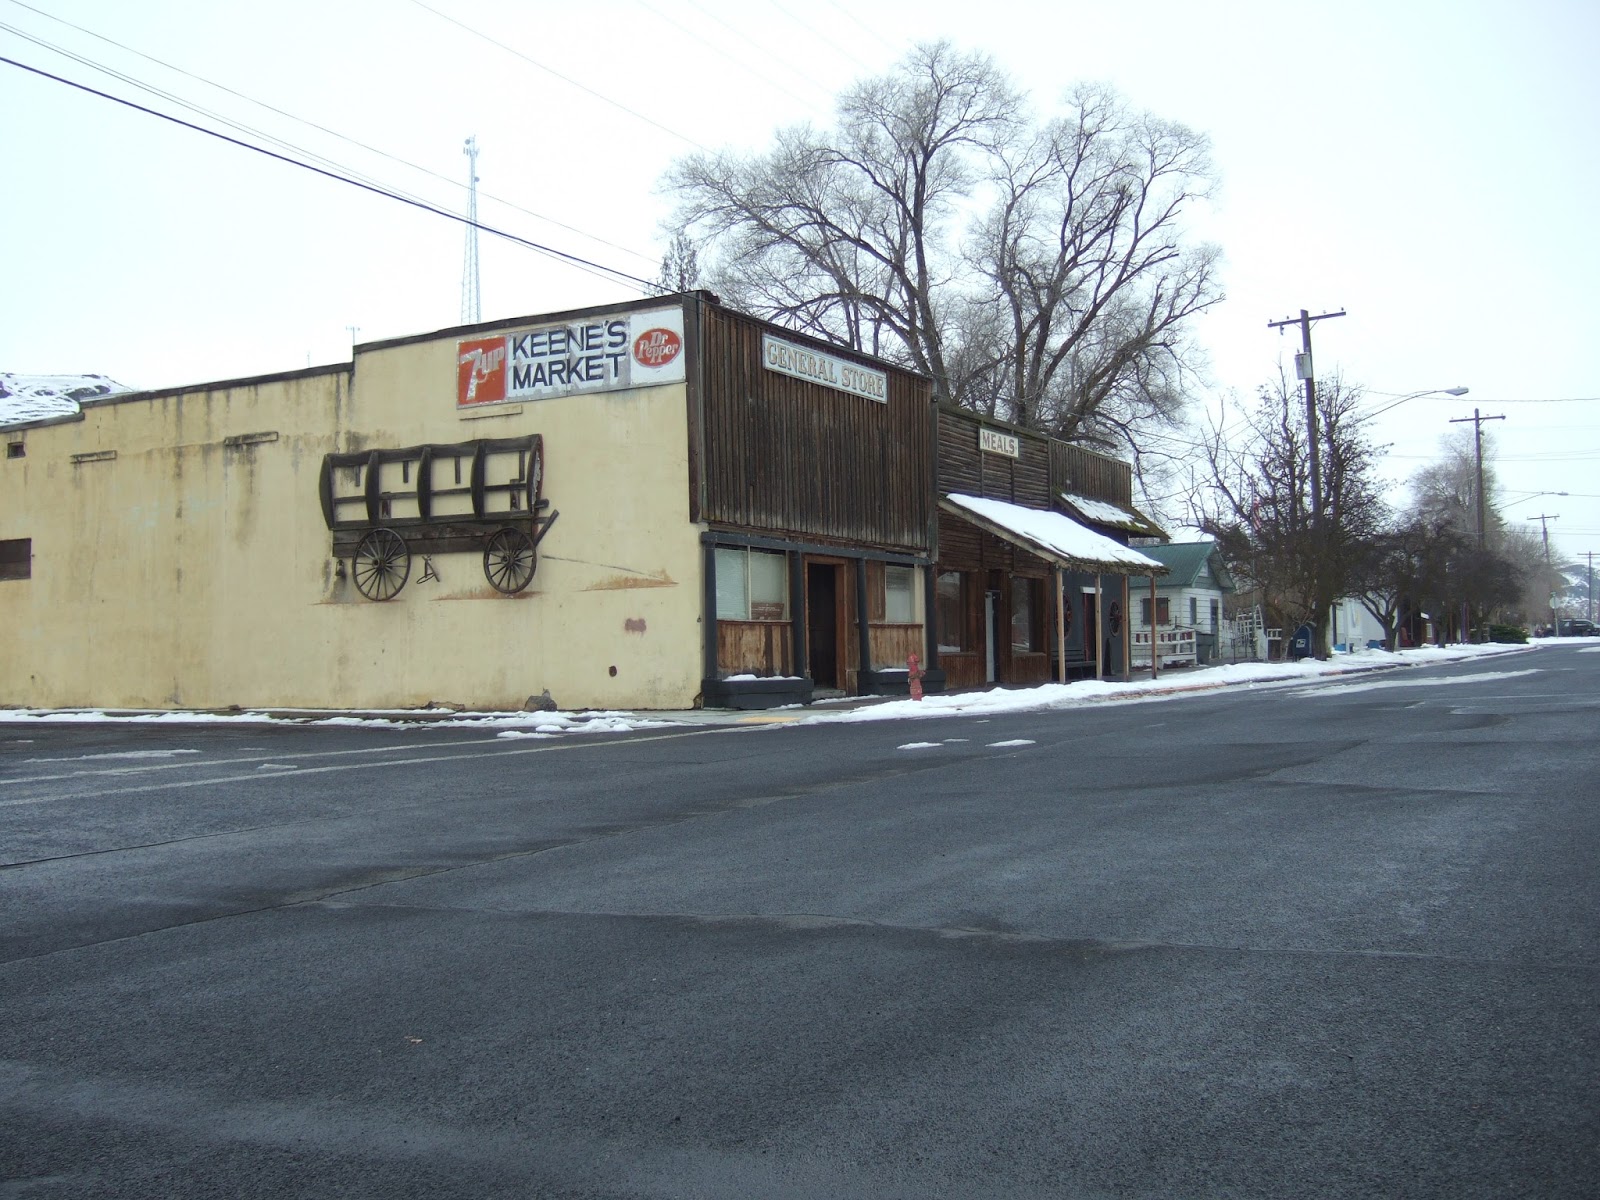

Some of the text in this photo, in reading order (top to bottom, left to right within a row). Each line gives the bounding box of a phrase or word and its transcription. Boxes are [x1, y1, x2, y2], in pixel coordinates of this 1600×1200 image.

[512, 320, 627, 360] KEENE'S
[638, 340, 679, 363] Pepper
[650, 331, 668, 347] Dr
[512, 352, 627, 390] MARKET
[766, 341, 885, 398] GENERAL STORE
[982, 431, 1015, 455] MEALS
